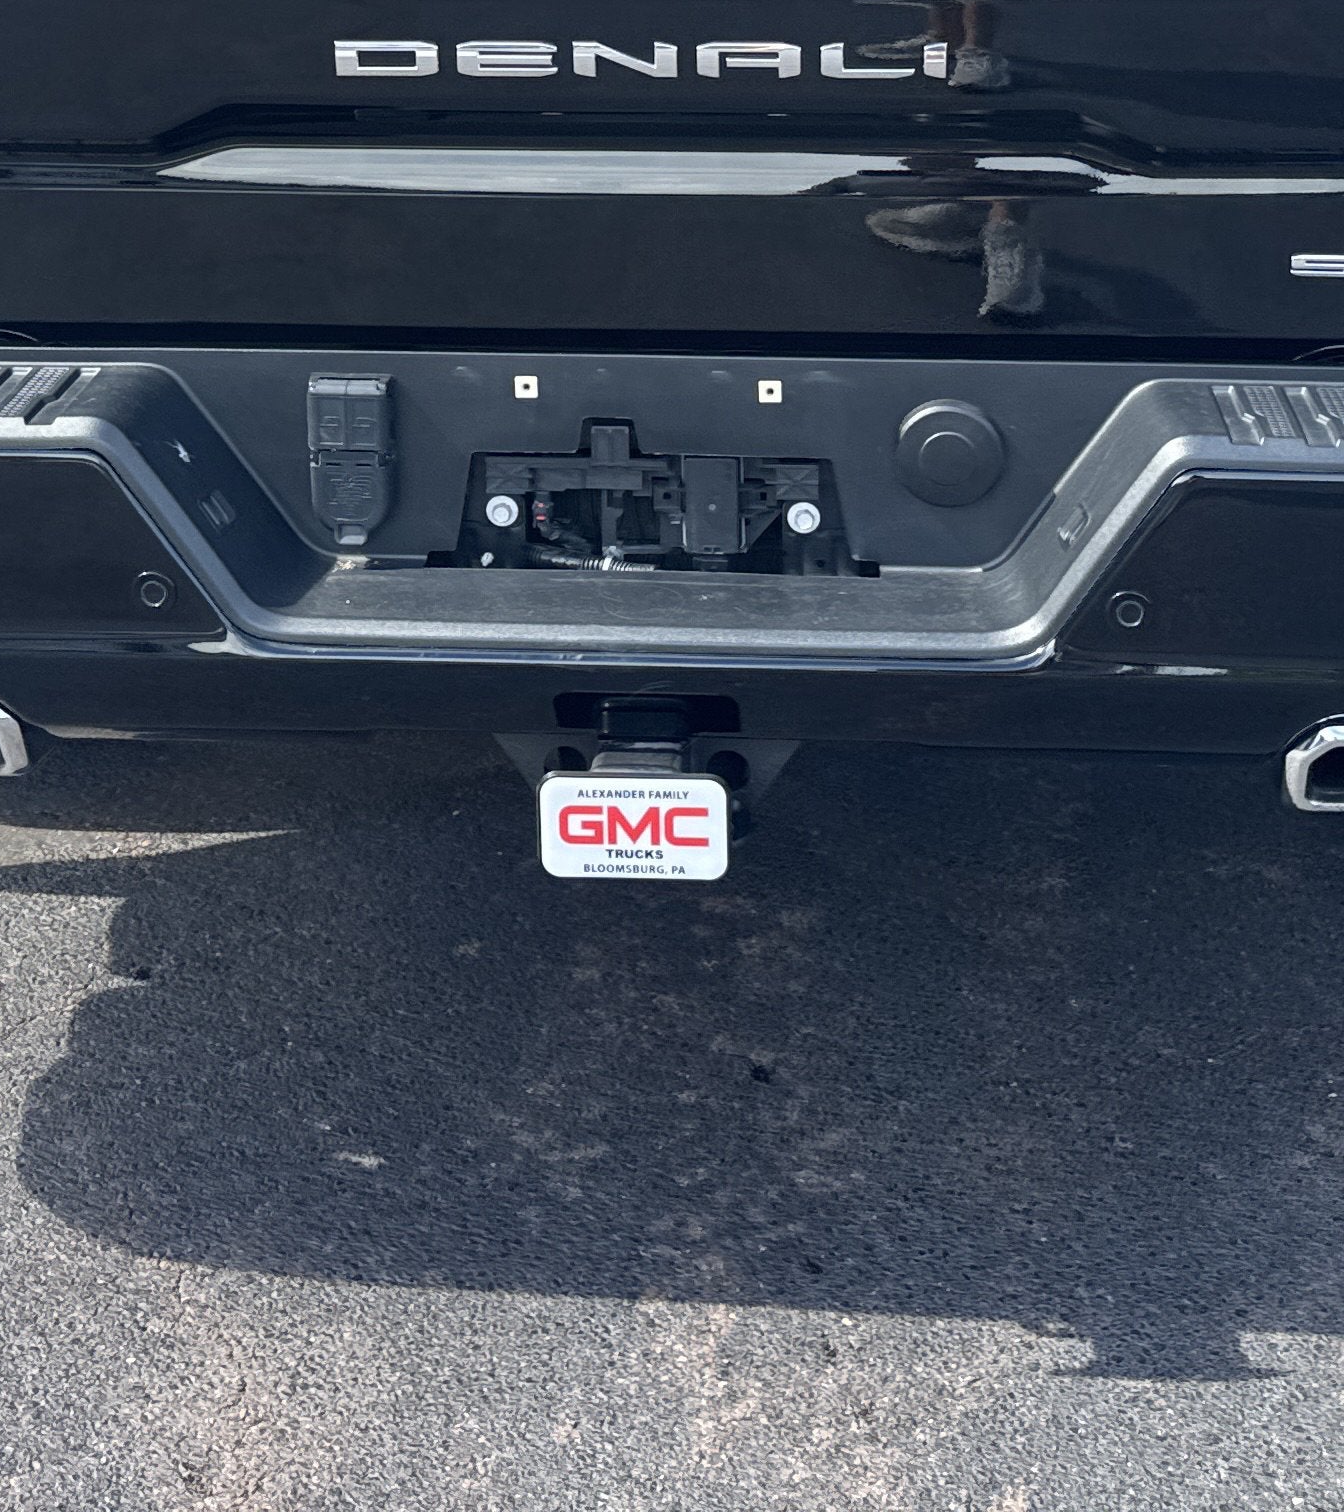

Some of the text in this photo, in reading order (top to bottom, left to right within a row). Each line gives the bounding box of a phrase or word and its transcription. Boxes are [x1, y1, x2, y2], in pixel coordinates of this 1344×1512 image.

[333, 40, 948, 79] DENALI
[577, 789, 690, 800] ALEXANDER FAMILY
[559, 805, 710, 847] GMC
[605, 849, 664, 859] TRUCKS
[583, 863, 686, 875] BLOOMSBURG, PA
